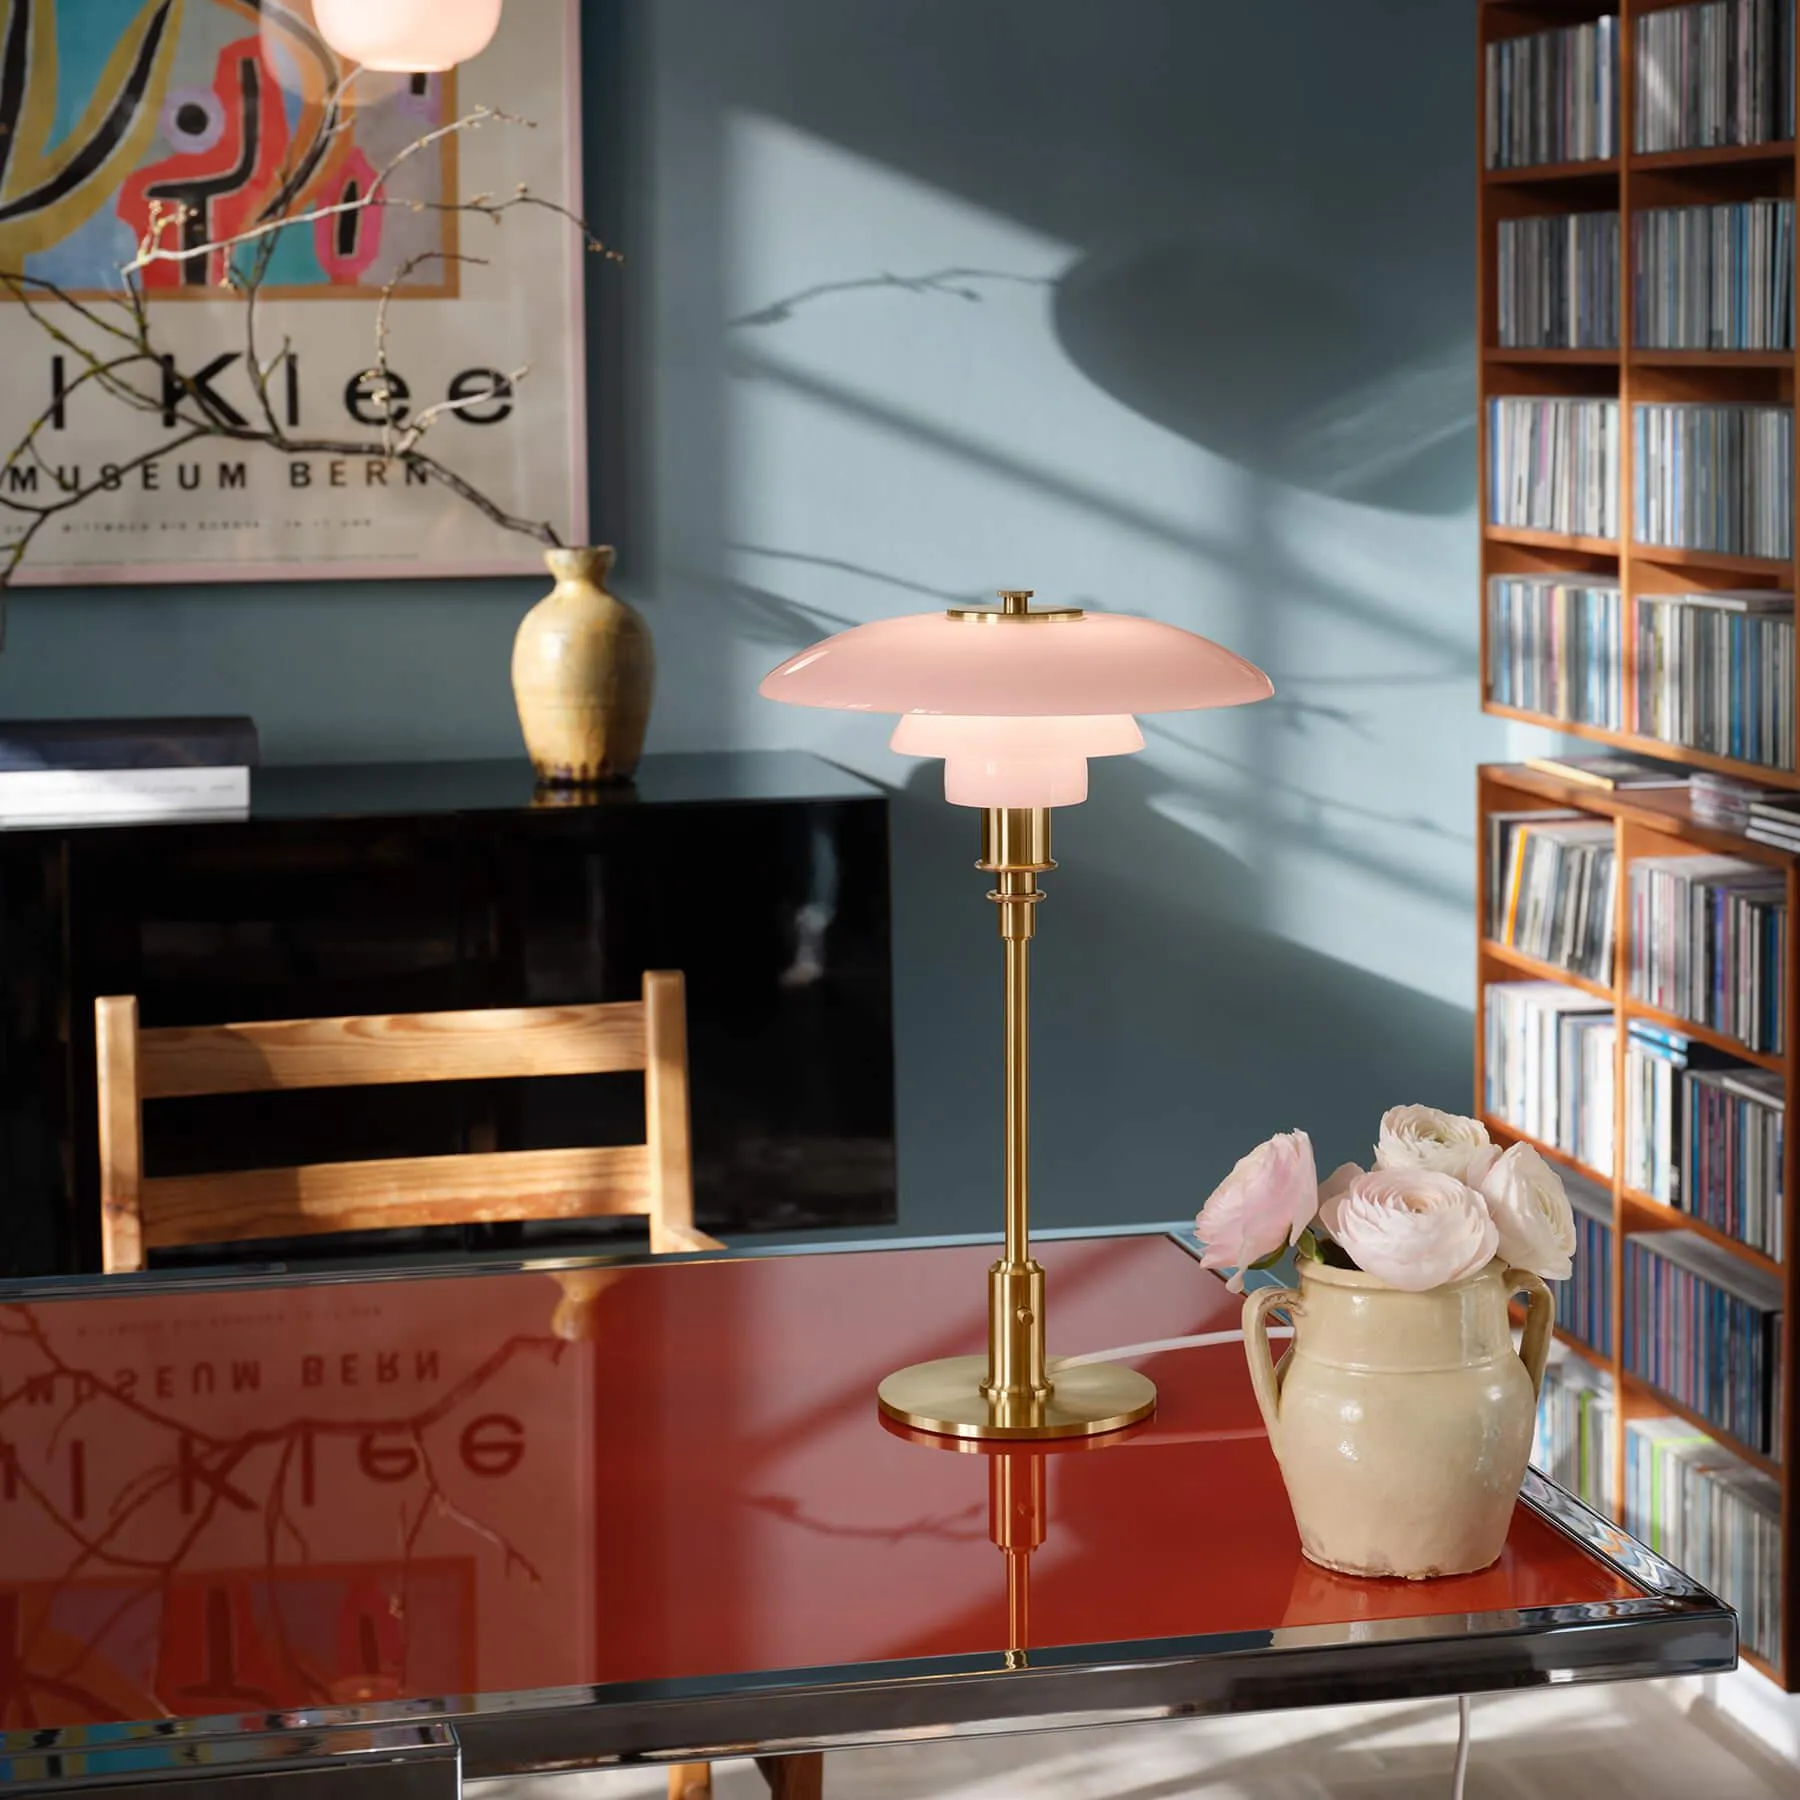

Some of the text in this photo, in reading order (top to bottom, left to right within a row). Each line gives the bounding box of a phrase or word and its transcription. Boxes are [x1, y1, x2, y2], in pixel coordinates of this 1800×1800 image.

[162, 351, 513, 427] Klee
[10, 461, 428, 492] MUSEUM BERN
